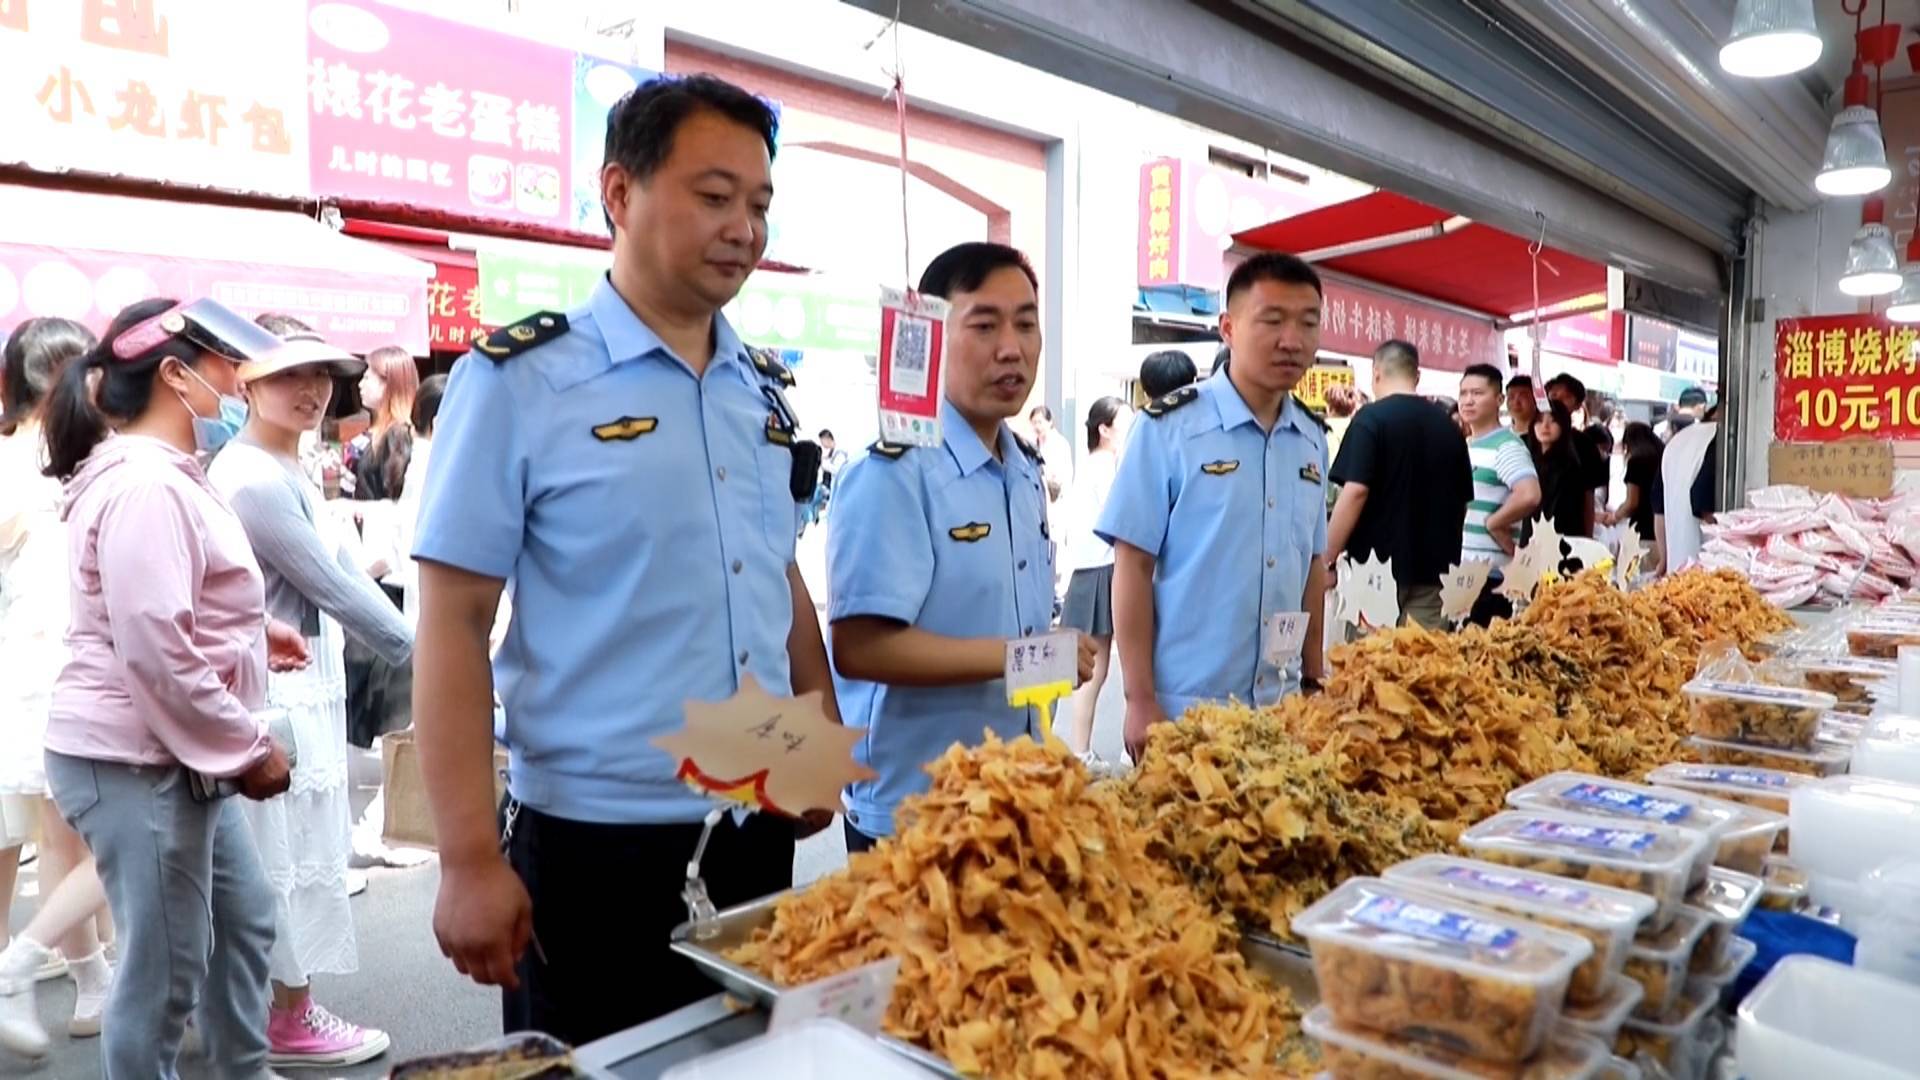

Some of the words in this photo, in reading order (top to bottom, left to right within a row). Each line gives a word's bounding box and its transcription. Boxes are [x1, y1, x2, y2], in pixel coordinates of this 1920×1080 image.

[35, 64, 292, 155] 小龙虾包
[307, 57, 561, 154] 裱花老蛋糕
[1783, 325, 1918, 379] 淄博烧烤
[1795, 384, 1920, 432] 10元10
